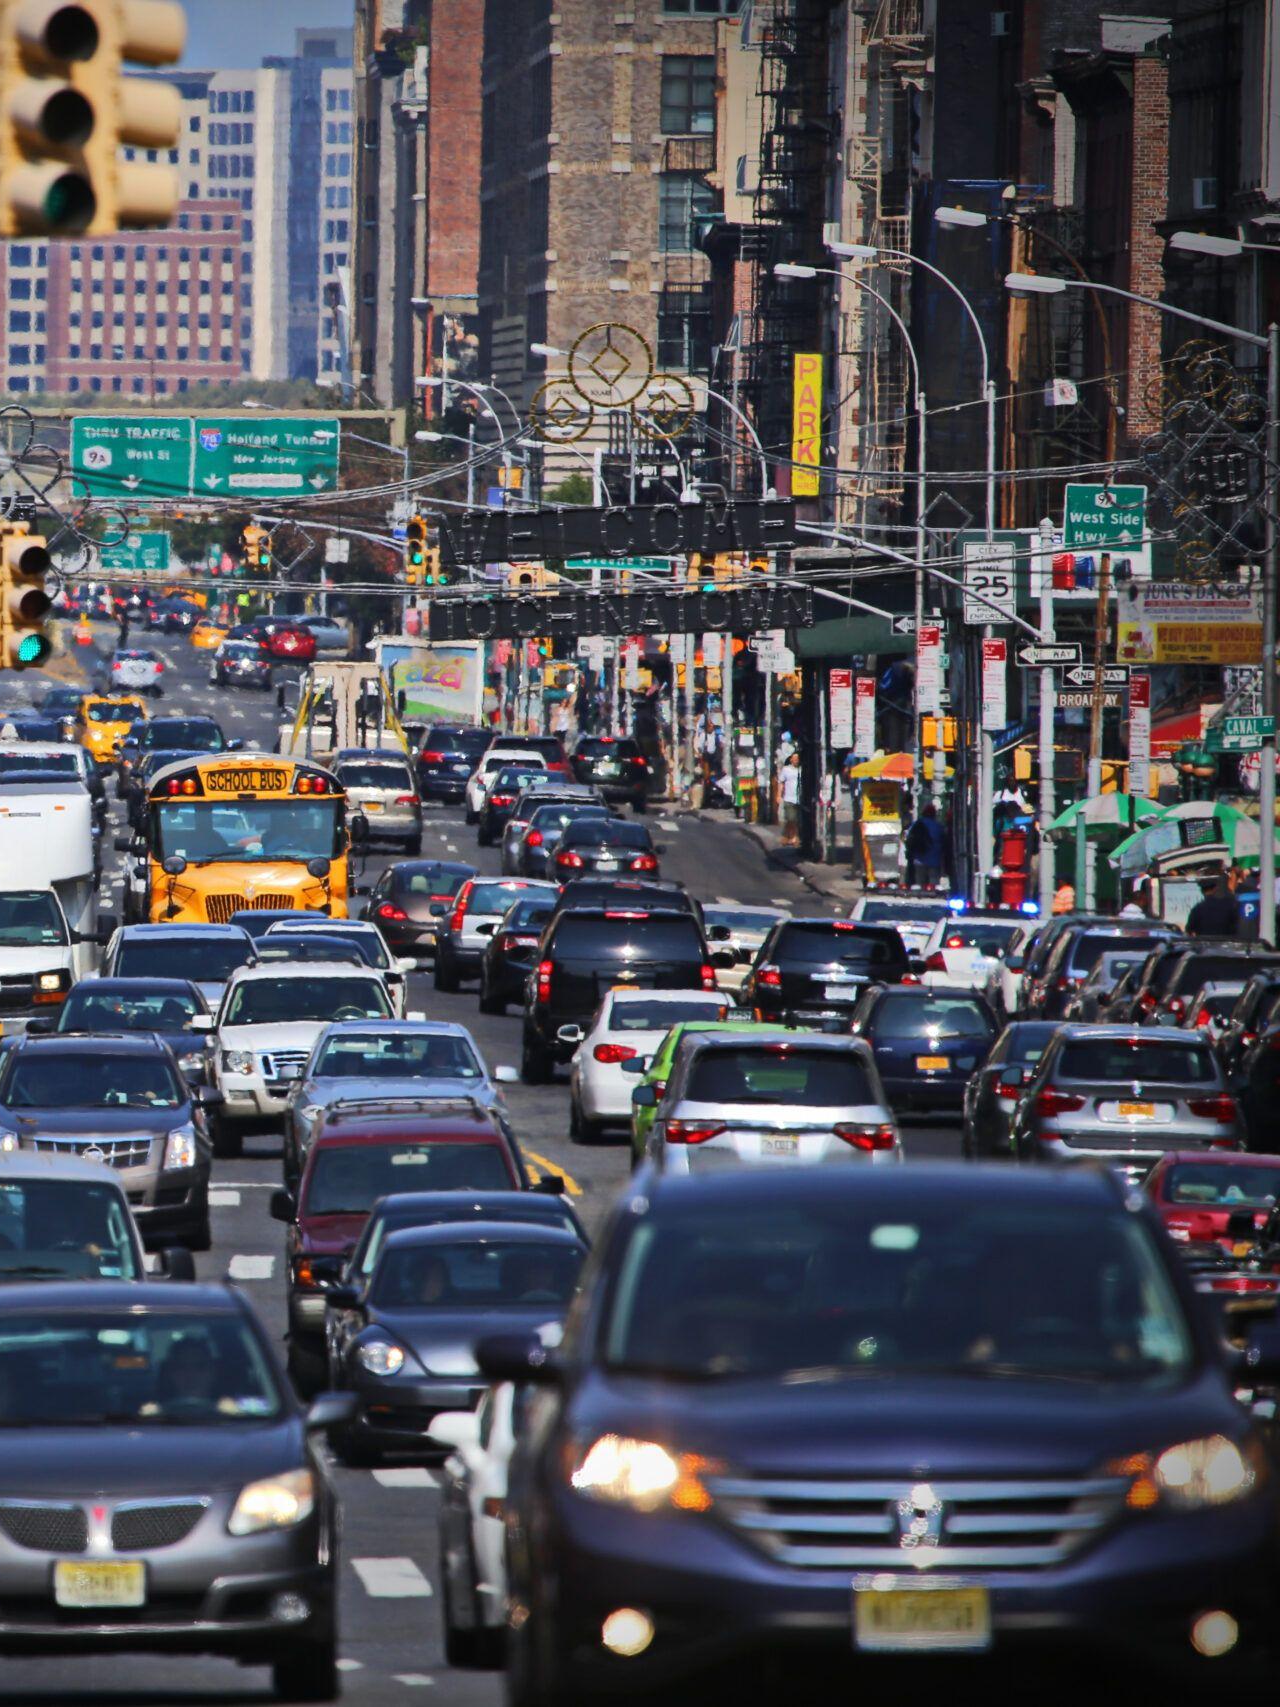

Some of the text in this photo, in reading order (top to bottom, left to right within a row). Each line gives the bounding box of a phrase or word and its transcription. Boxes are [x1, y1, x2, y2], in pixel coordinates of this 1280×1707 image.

[797, 357, 818, 463] PARK
[126, 427, 181, 439] TRAFFIC
[227, 433, 278, 445] Holland
[1070, 512, 1140, 526] West Side
[438, 500, 795, 564] WELCOME
[1074, 531, 1107, 547] Hwy
[972, 576, 1009, 597] 25
[1073, 671, 1093, 680] ONE
[1060, 693, 1118, 706] BROAAY
[1226, 719, 1273, 735] CANAL ST
[209, 771, 282, 790] SCHOOL BUS
